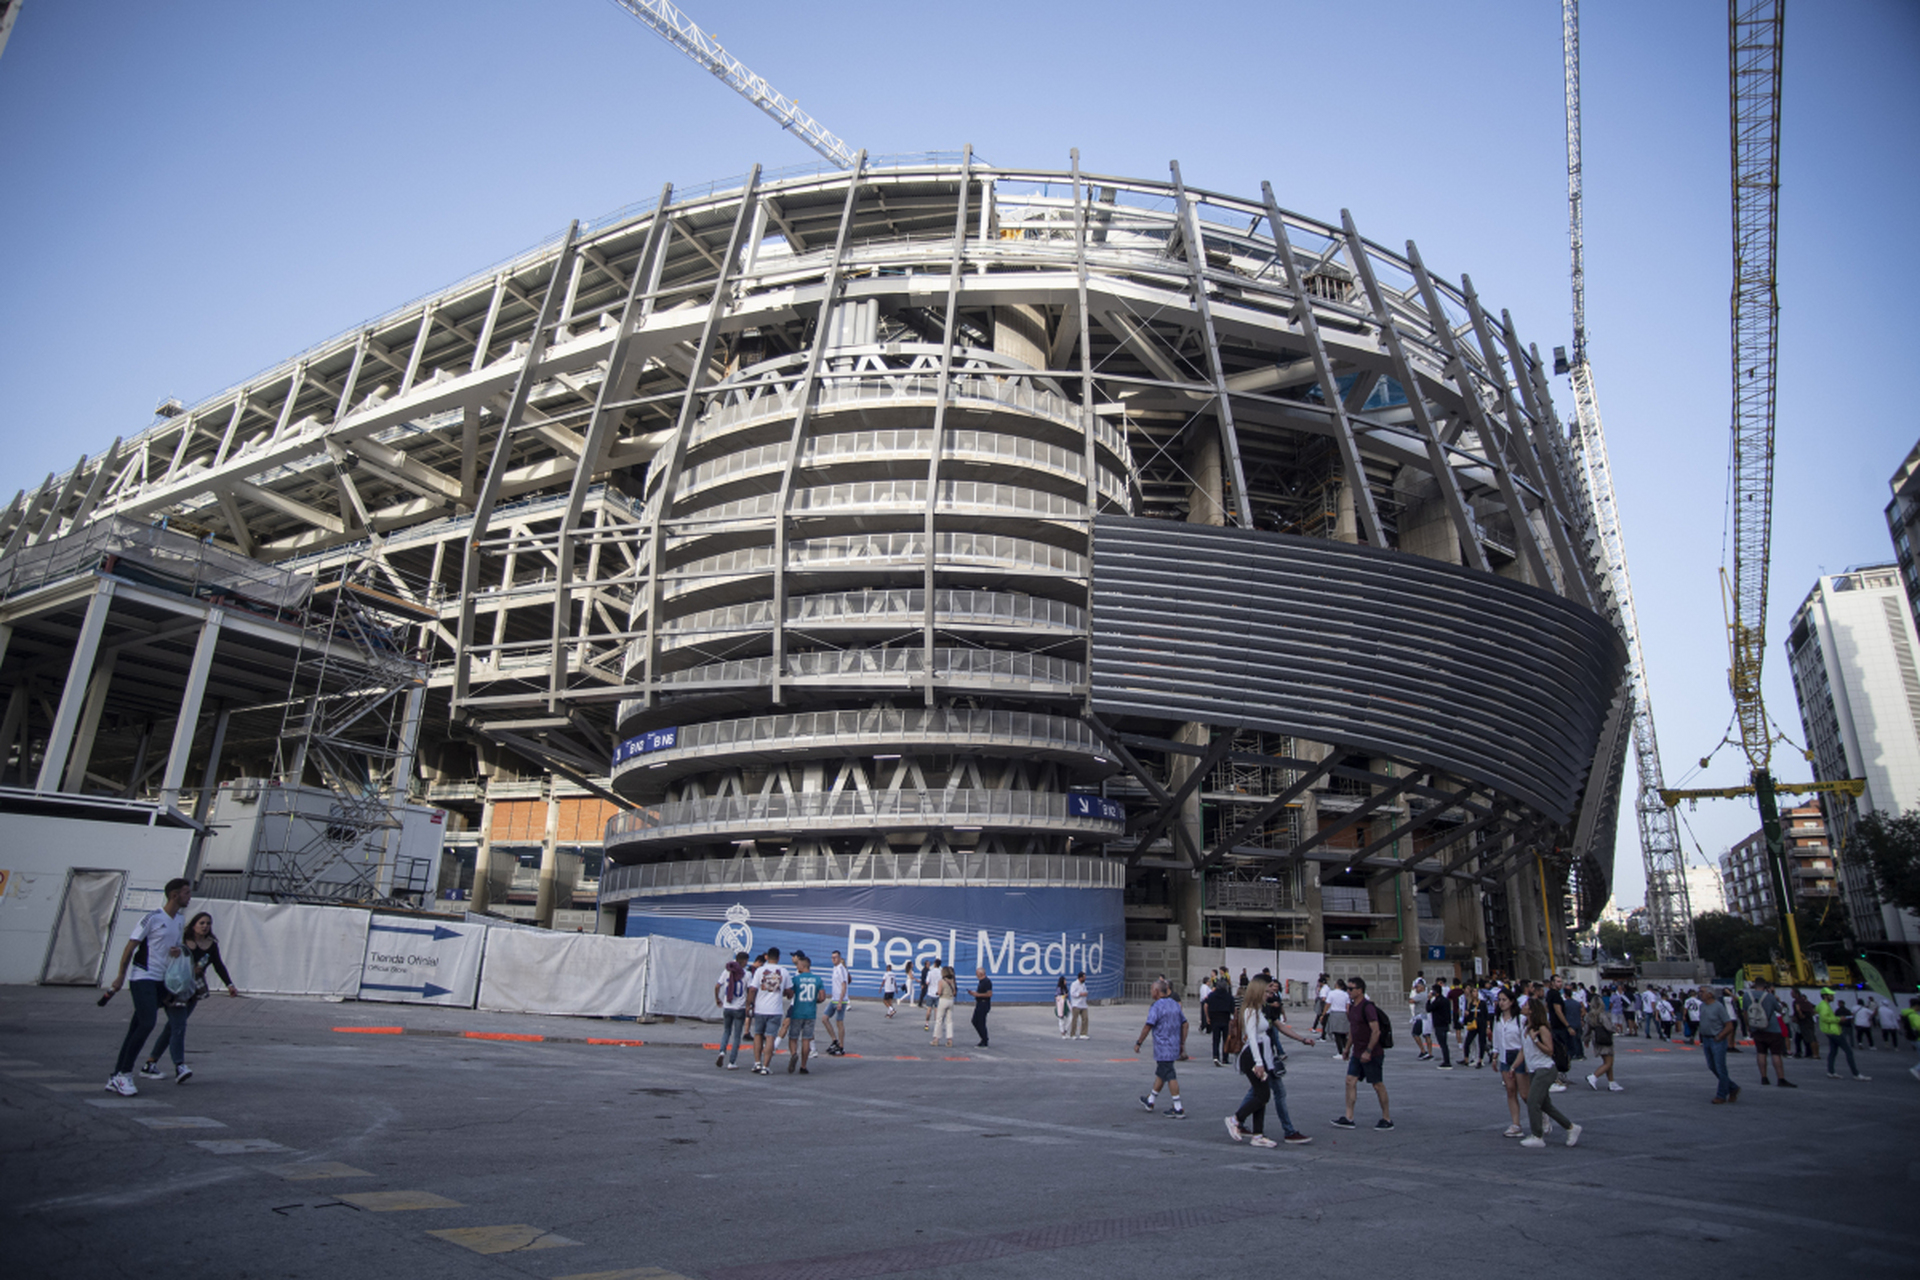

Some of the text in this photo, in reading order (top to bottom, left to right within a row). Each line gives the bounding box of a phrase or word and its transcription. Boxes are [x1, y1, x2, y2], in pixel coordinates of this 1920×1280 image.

[371, 952, 404, 965] Tienda
[847, 923, 1103, 975] Real Madrid
[799, 983, 816, 1002] 20
